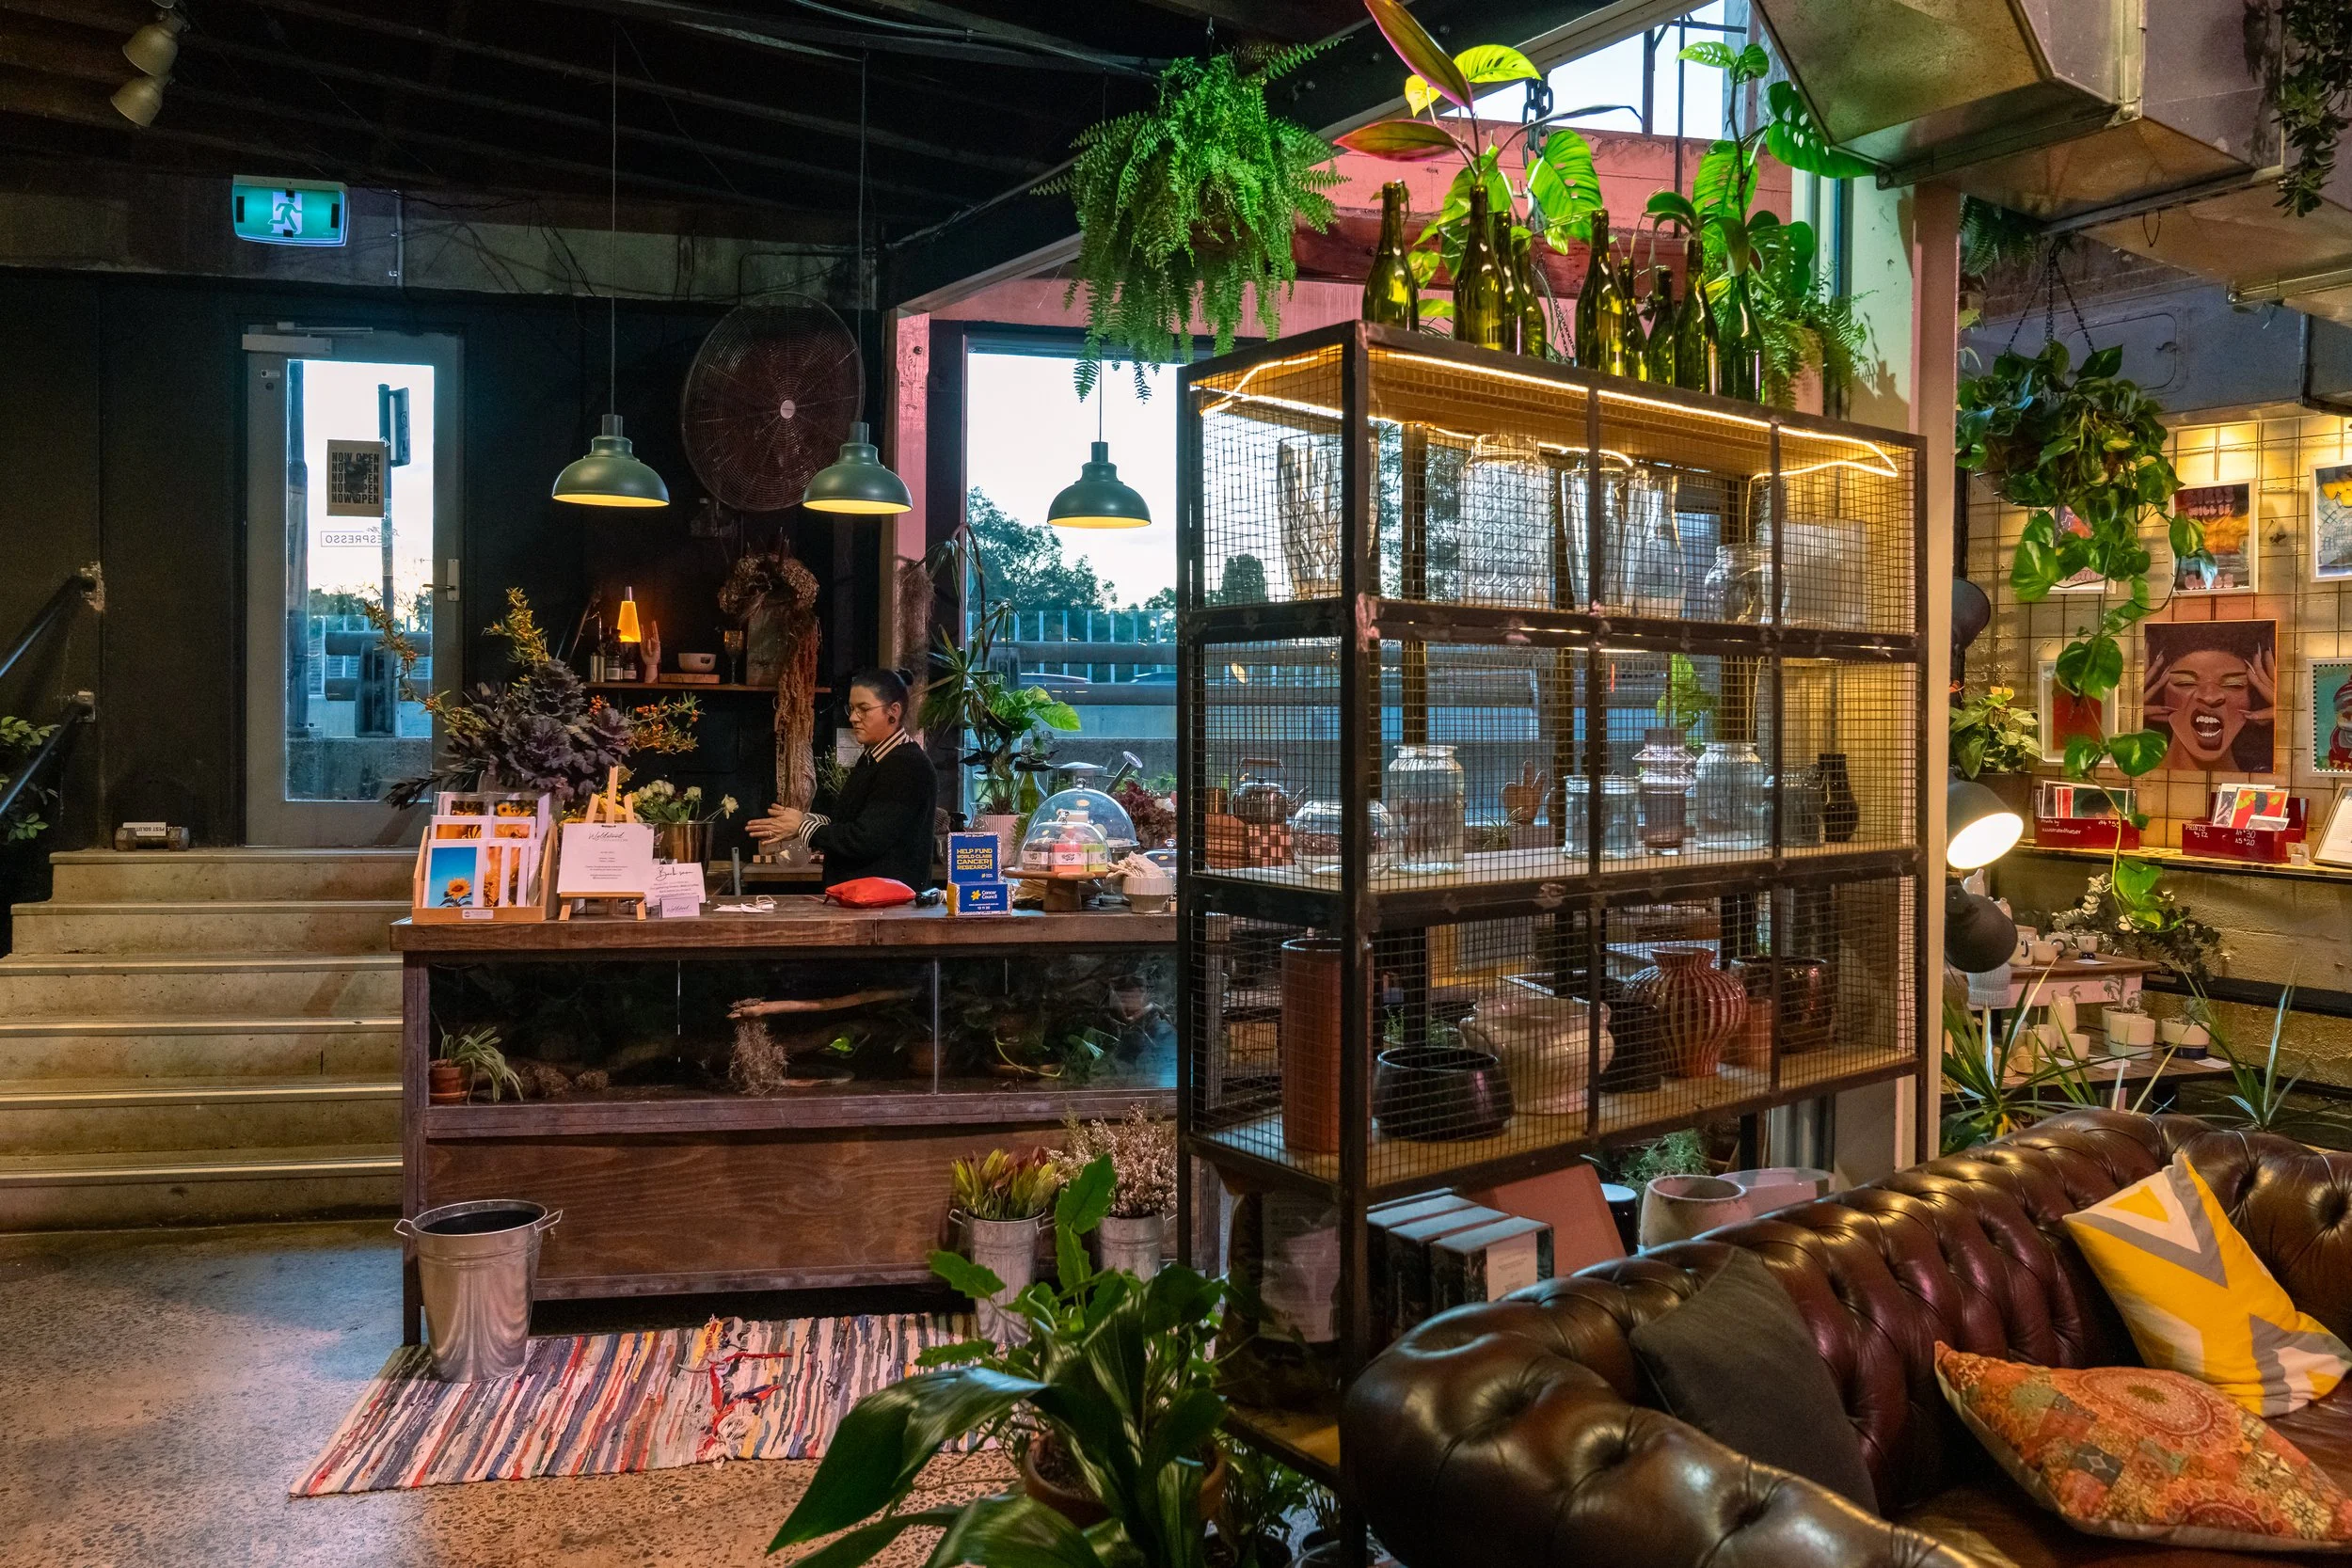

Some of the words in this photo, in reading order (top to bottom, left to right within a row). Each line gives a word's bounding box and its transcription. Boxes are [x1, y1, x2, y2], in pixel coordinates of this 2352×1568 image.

[332, 452, 352, 462] NOW
[332, 493, 352, 503] NOW
[656, 866, 677, 881] Back
